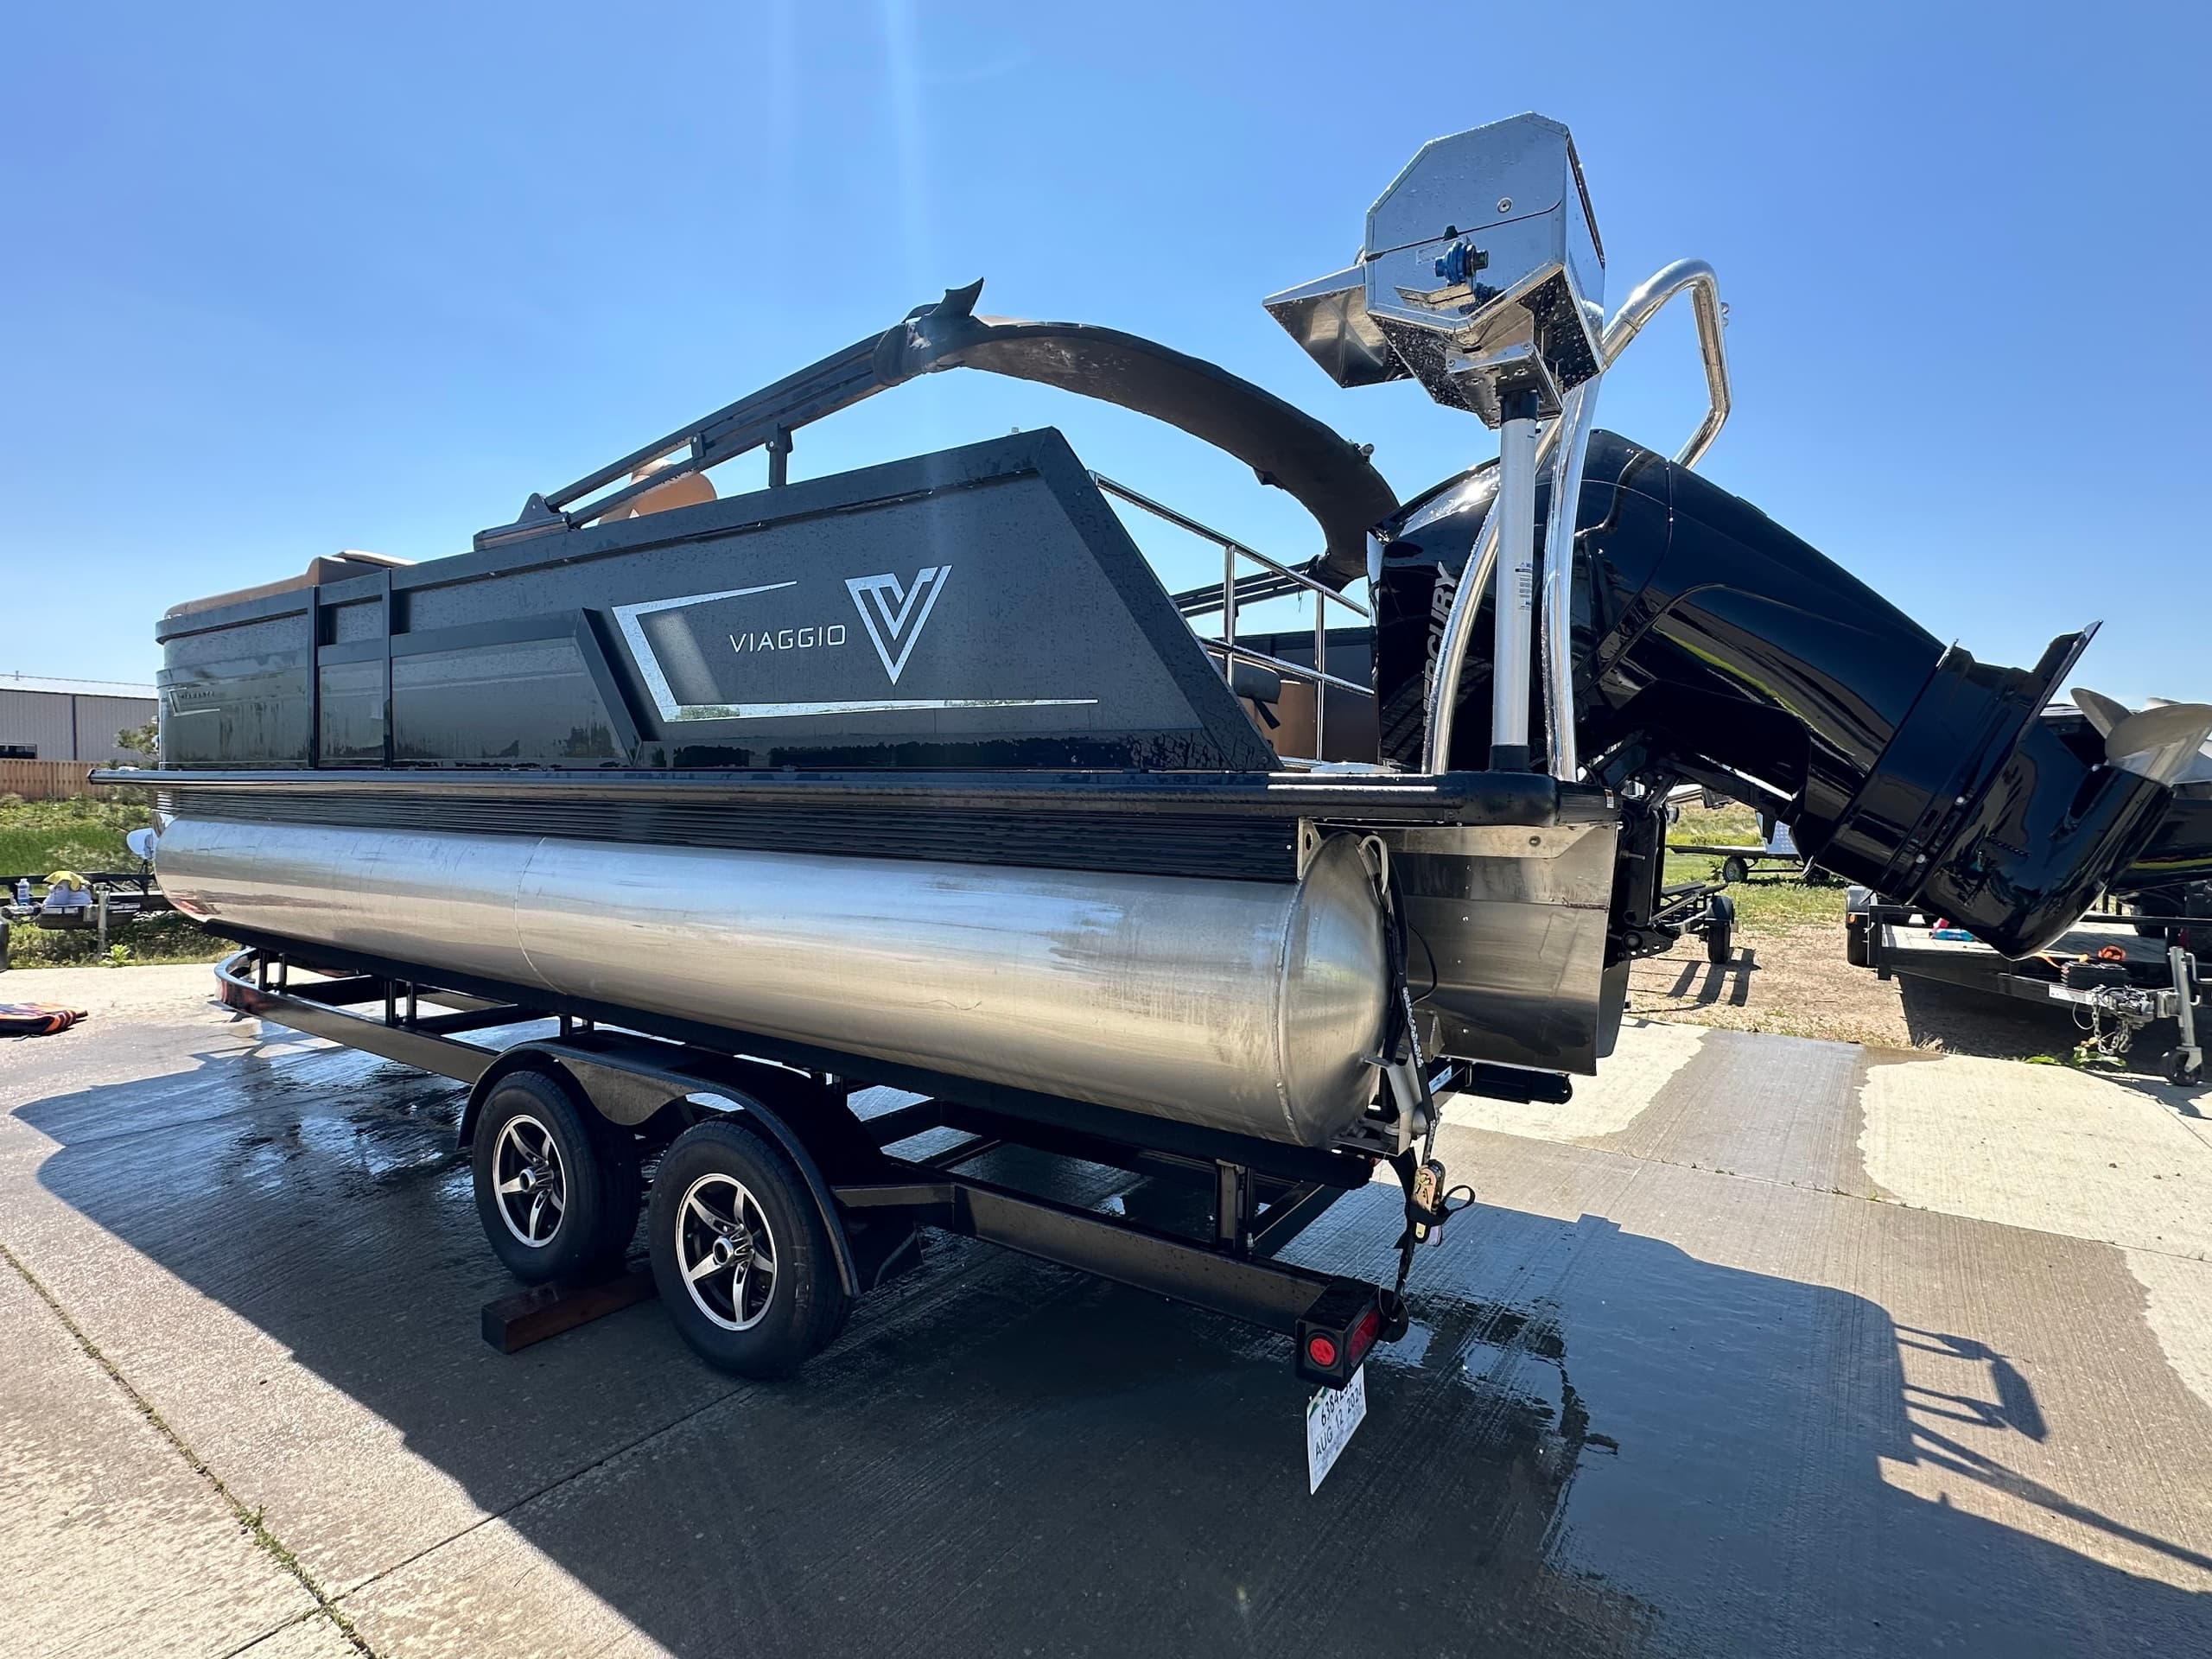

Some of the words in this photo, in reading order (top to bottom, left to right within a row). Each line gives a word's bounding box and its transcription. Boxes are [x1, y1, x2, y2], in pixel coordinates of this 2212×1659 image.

[729, 624, 846, 652] VIAGGIO
[1315, 1426, 1333, 1461] AUG
[1335, 1408, 1344, 1429] 12
